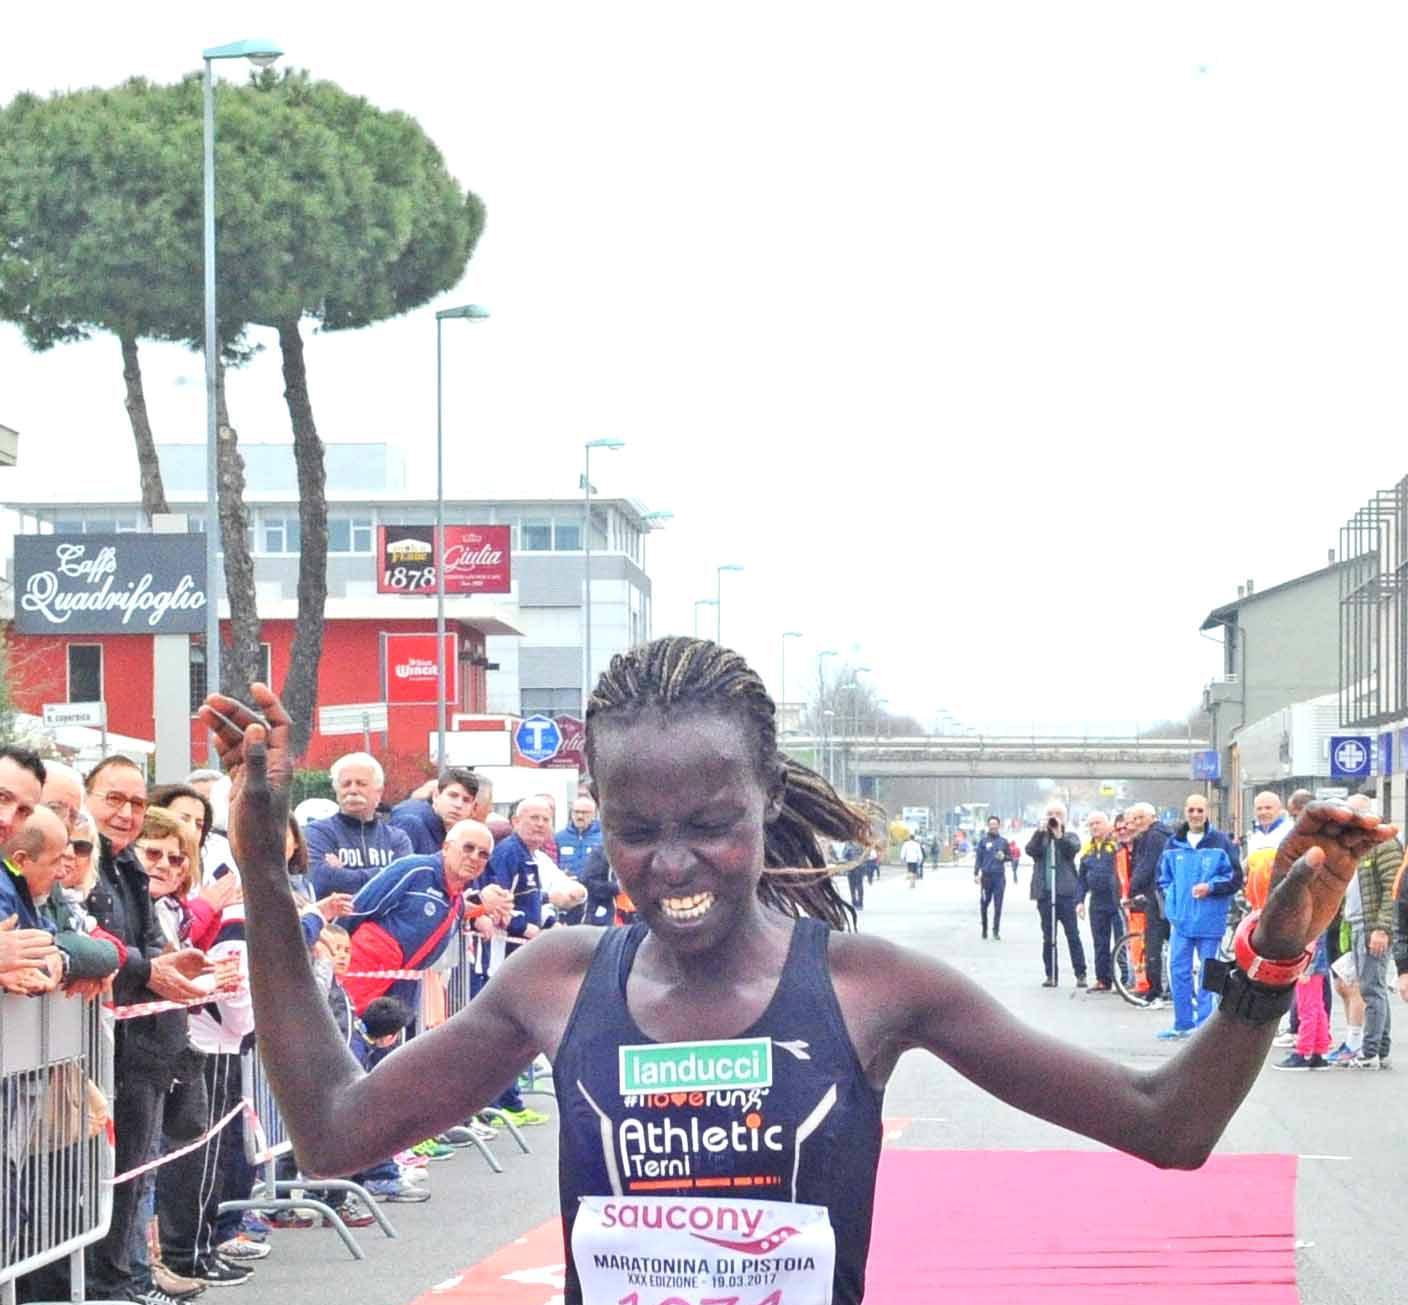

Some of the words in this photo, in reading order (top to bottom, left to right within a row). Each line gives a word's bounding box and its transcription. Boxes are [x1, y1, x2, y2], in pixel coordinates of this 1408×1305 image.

[443, 544, 503, 573] Giulia
[384, 567, 436, 591] 1878
[21, 571, 207, 626] Quadrifoglio
[633, 1050, 760, 1085] landucci
[619, 1113, 783, 1177] Athletic
[630, 1154, 691, 1177] Terni
[601, 1203, 764, 1238] saucony
[594, 1254, 709, 1274] MARATONINA
[717, 1258, 734, 1274] DI
[742, 1256, 815, 1273] PISTOIA
[628, 1273, 646, 1287] XXX
[649, 1275, 697, 1288] EDIZIONE
[712, 1273, 776, 1288] 19.03.2017
